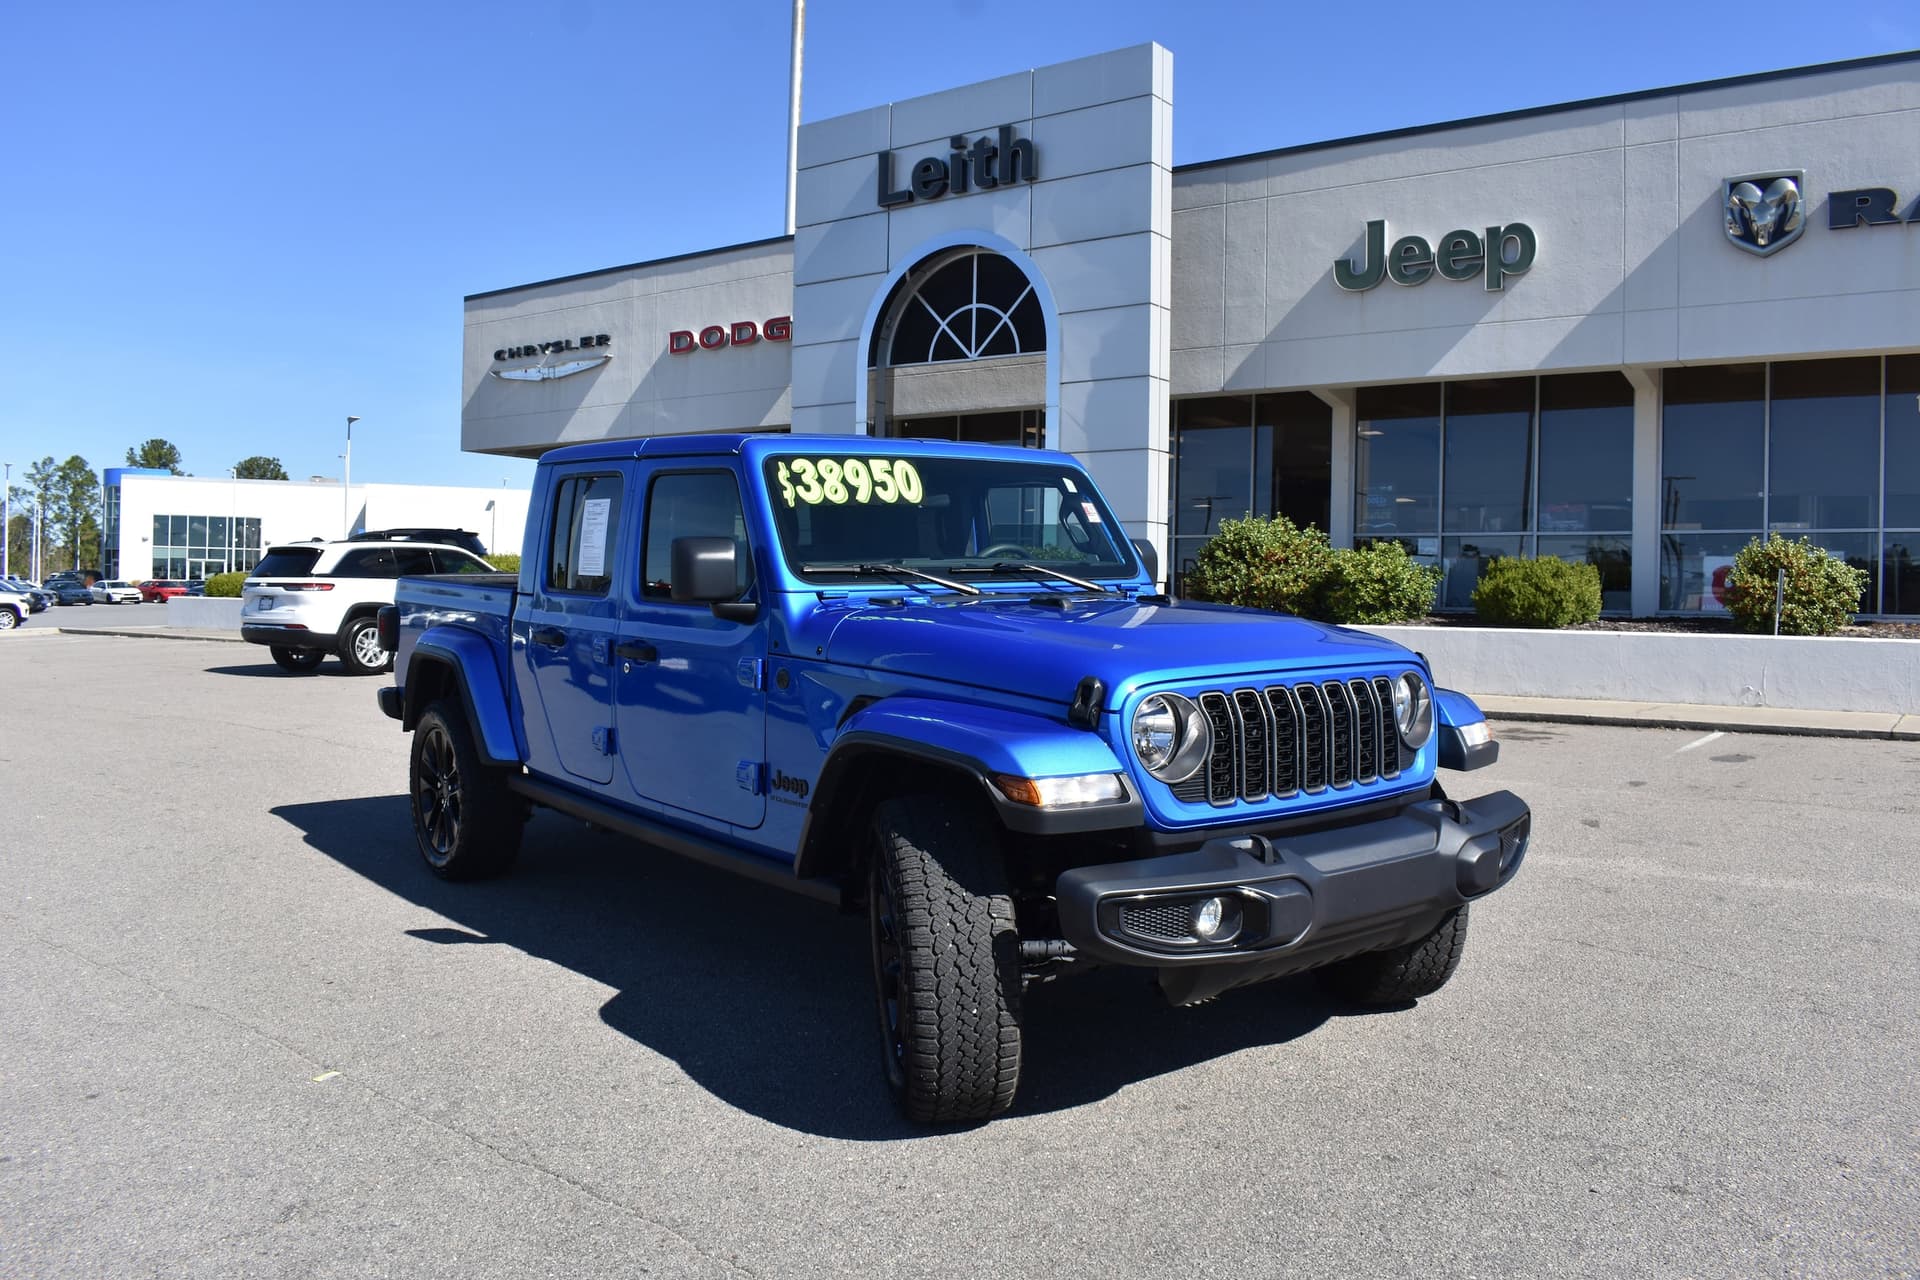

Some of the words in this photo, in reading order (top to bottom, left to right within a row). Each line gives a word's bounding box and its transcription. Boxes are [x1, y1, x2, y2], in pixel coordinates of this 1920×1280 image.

[878, 125, 1038, 207] Leith
[1828, 188, 1920, 230] R
[1333, 219, 1537, 292] Jeep
[494, 334, 611, 361] CHRYSLER
[669, 315, 793, 355] DODG
[778, 458, 923, 508] $38950
[771, 769, 809, 799] Jeep
